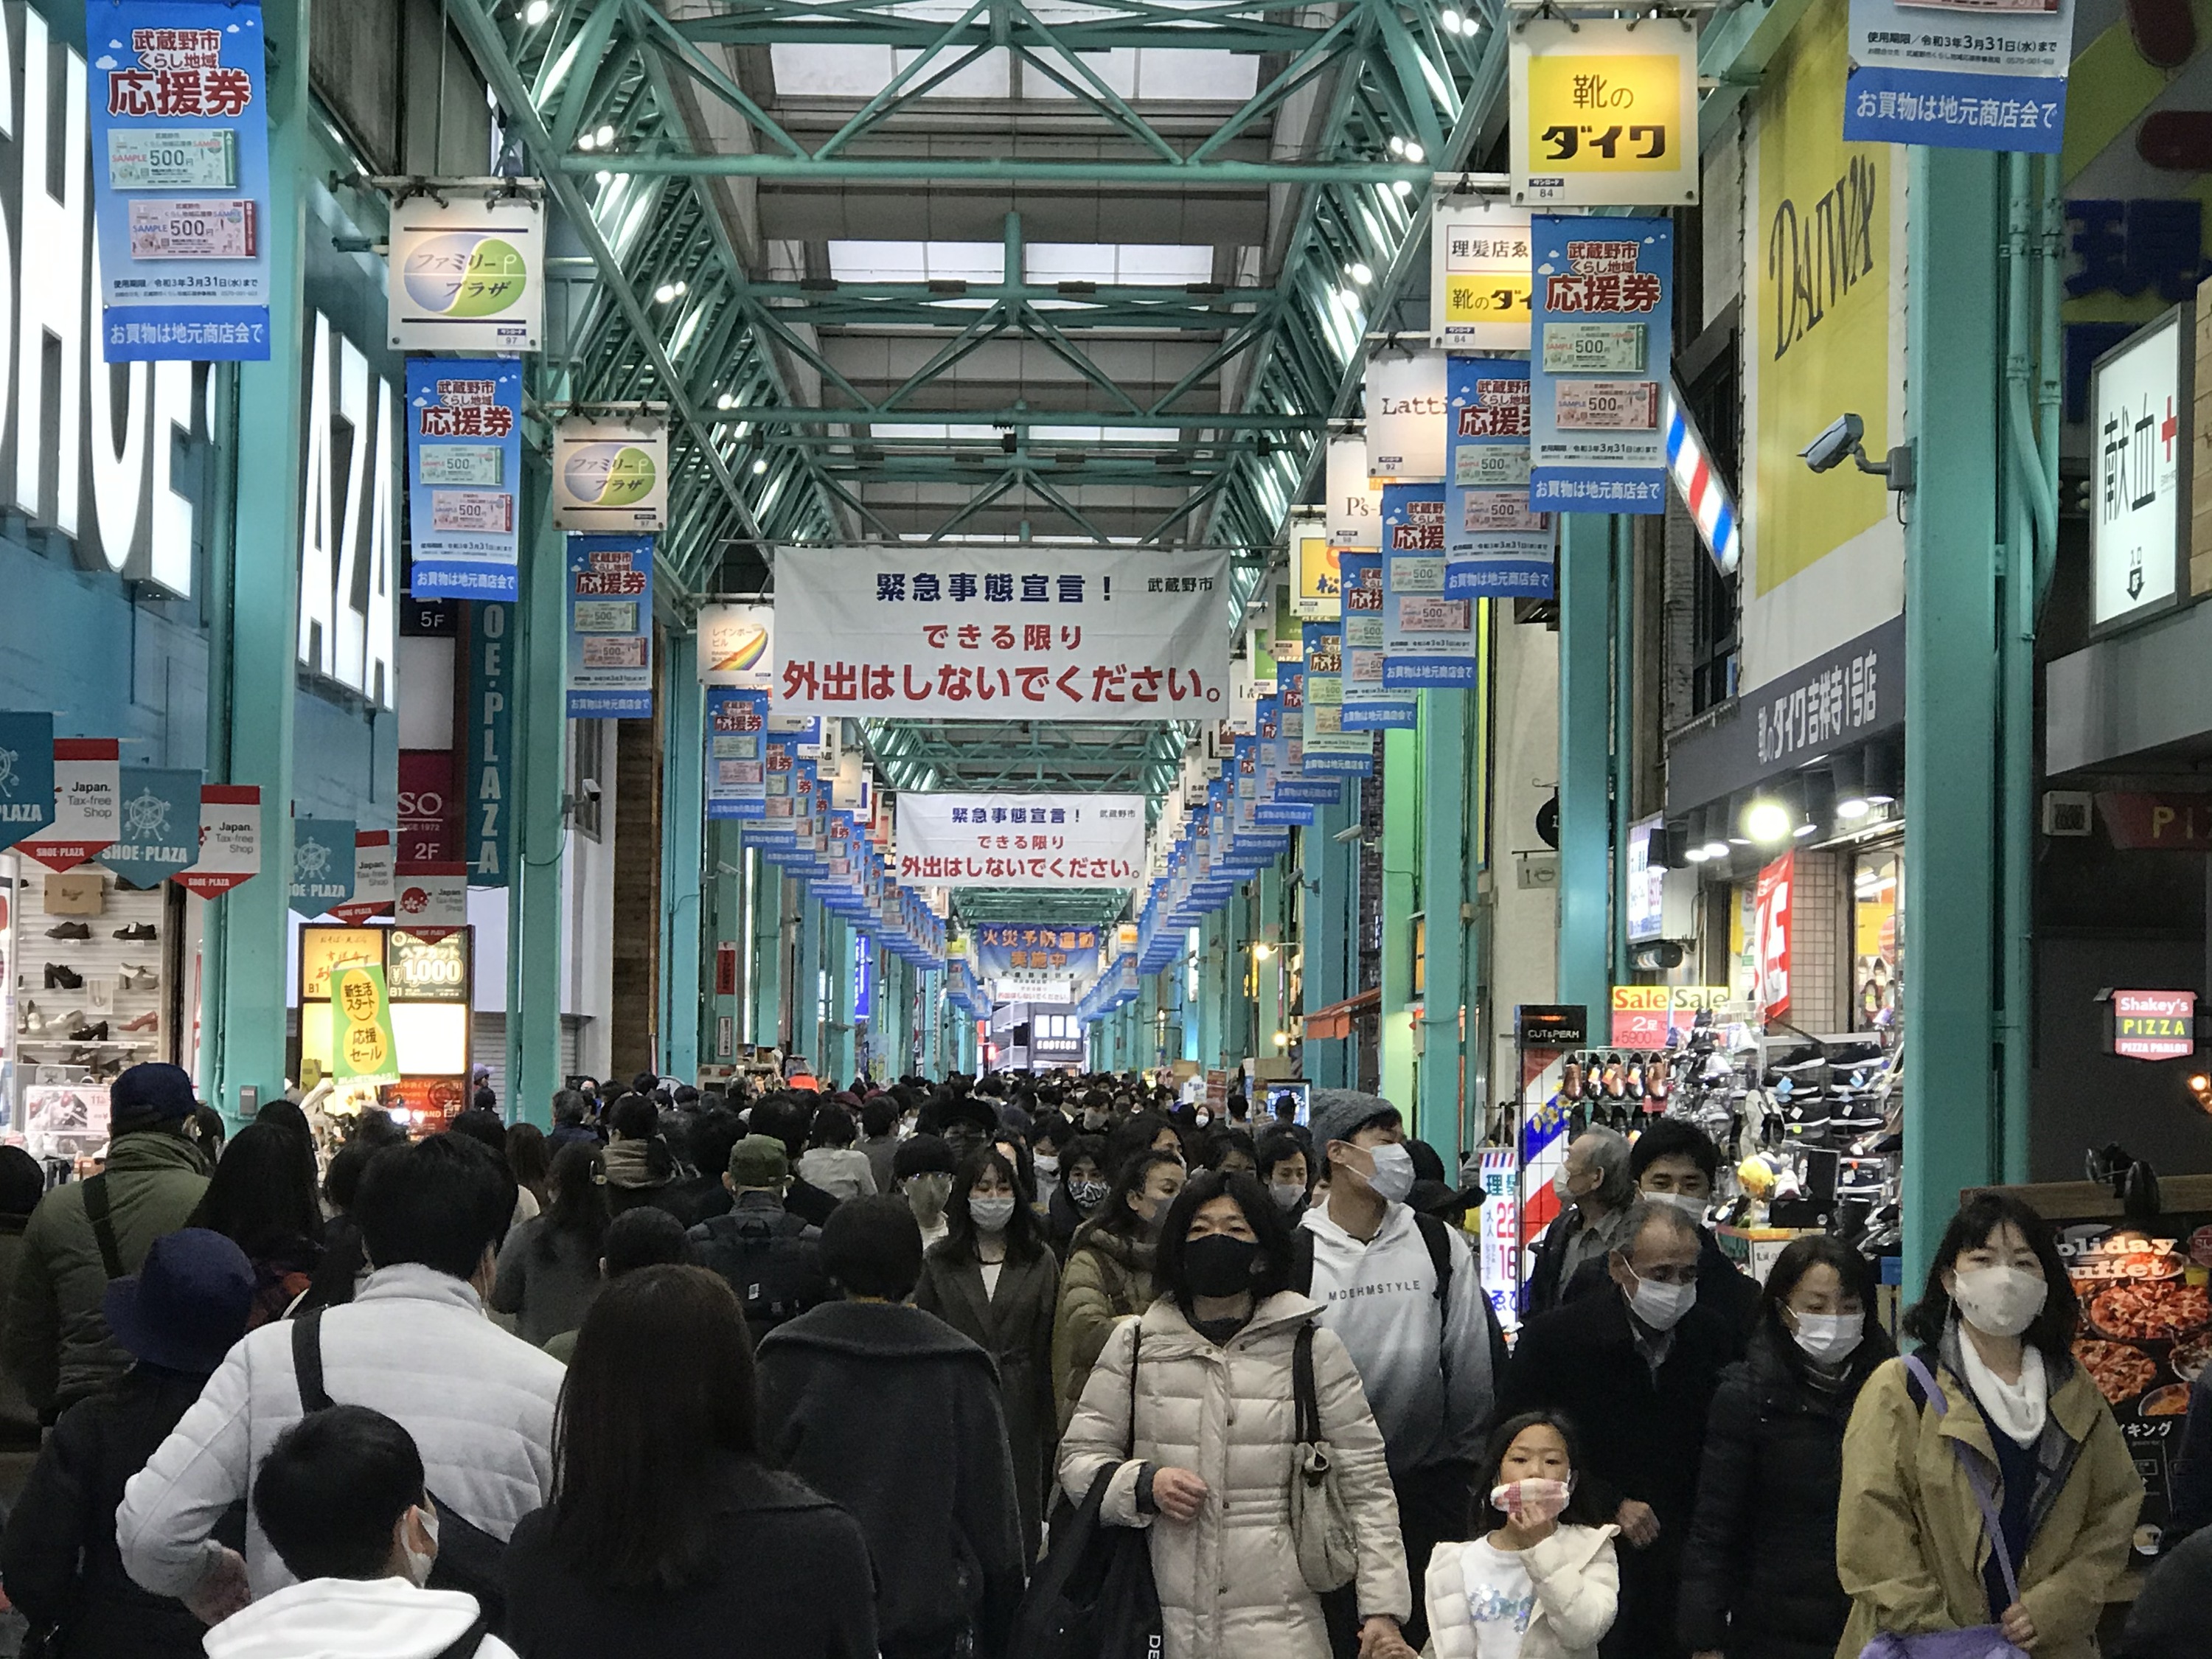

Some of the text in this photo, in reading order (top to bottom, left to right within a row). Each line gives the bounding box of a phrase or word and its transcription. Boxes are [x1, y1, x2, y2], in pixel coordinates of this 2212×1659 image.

[133, 30, 220, 52] 武蔵野市
[139, 53, 218, 69] くらし地域
[109, 69, 251, 115] 応援券
[1573, 74, 1635, 109] 靴の
[1857, 90, 2059, 129] お買物は地元商店会で
[1541, 125, 1666, 160] ダイワ
[112, 154, 147, 162] SAMPLE
[1539, 189, 1554, 198] 84
[133, 224, 167, 233] SAMPLE
[1568, 242, 1640, 260] 武蔵野市
[415, 253, 496, 271] ファミリー
[1571, 260, 1636, 274] くらし地域
[442, 280, 512, 299] プラザ
[1545, 275, 1660, 313] 応援券
[111, 322, 264, 345] お買物は地元商店会で
[506, 336, 518, 344] 97
[1454, 335, 1467, 344] 84
[437, 380, 495, 394] 武蔵野市
[440, 395, 493, 406] くらし地域
[420, 406, 513, 437] 応援券
[574, 459, 633, 471] ファミリー
[2104, 392, 2156, 526] 献血
[594, 479, 645, 492] プラザ
[1536, 480, 1660, 500] お買物は地元商店会で
[1392, 524, 1445, 551] 応援
[2130, 546, 2142, 567] 入口
[417, 572, 515, 590] お買物は地元商店会で
[576, 572, 647, 594] 応援券
[876, 572, 1214, 603] 緊急事態宣言！ 武蔵野市
[1449, 571, 1549, 589] お買物は地元商店会で
[420, 611, 445, 627] 5F
[922, 624, 1082, 652] できる限り
[782, 660, 1221, 704] 外出はしないでください。
[72, 781, 112, 793] Japan.
[67, 795, 112, 807] Tax-free
[83, 807, 113, 820] Shop
[219, 822, 254, 832] Japan.
[215, 832, 254, 844] Tax-free
[978, 835, 1065, 850] できる限り
[229, 844, 254, 855] Shop
[414, 843, 440, 860] 2F
[901, 855, 1141, 880] 外出はしないでください。
[399, 945, 461, 959] ヘアカット
[390, 958, 464, 987] ¥1,000
[308, 983, 319, 993] B1
[344, 982, 373, 998] 新生活
[389, 987, 403, 997] B1
[346, 998, 375, 1012] スタート
[1614, 988, 1730, 1009] Sale Sale
[2120, 996, 2189, 1015] Shakey's
[1631, 1015, 1658, 1032] 2足
[2124, 1019, 2185, 1036] PIZZA
[352, 1027, 378, 1045] 応援
[349, 1046, 382, 1062] セール
[2121, 1042, 2149, 1053] PIZZA
[2056, 1235, 2179, 1257] oliday
[2068, 1258, 2166, 1280] uffet
